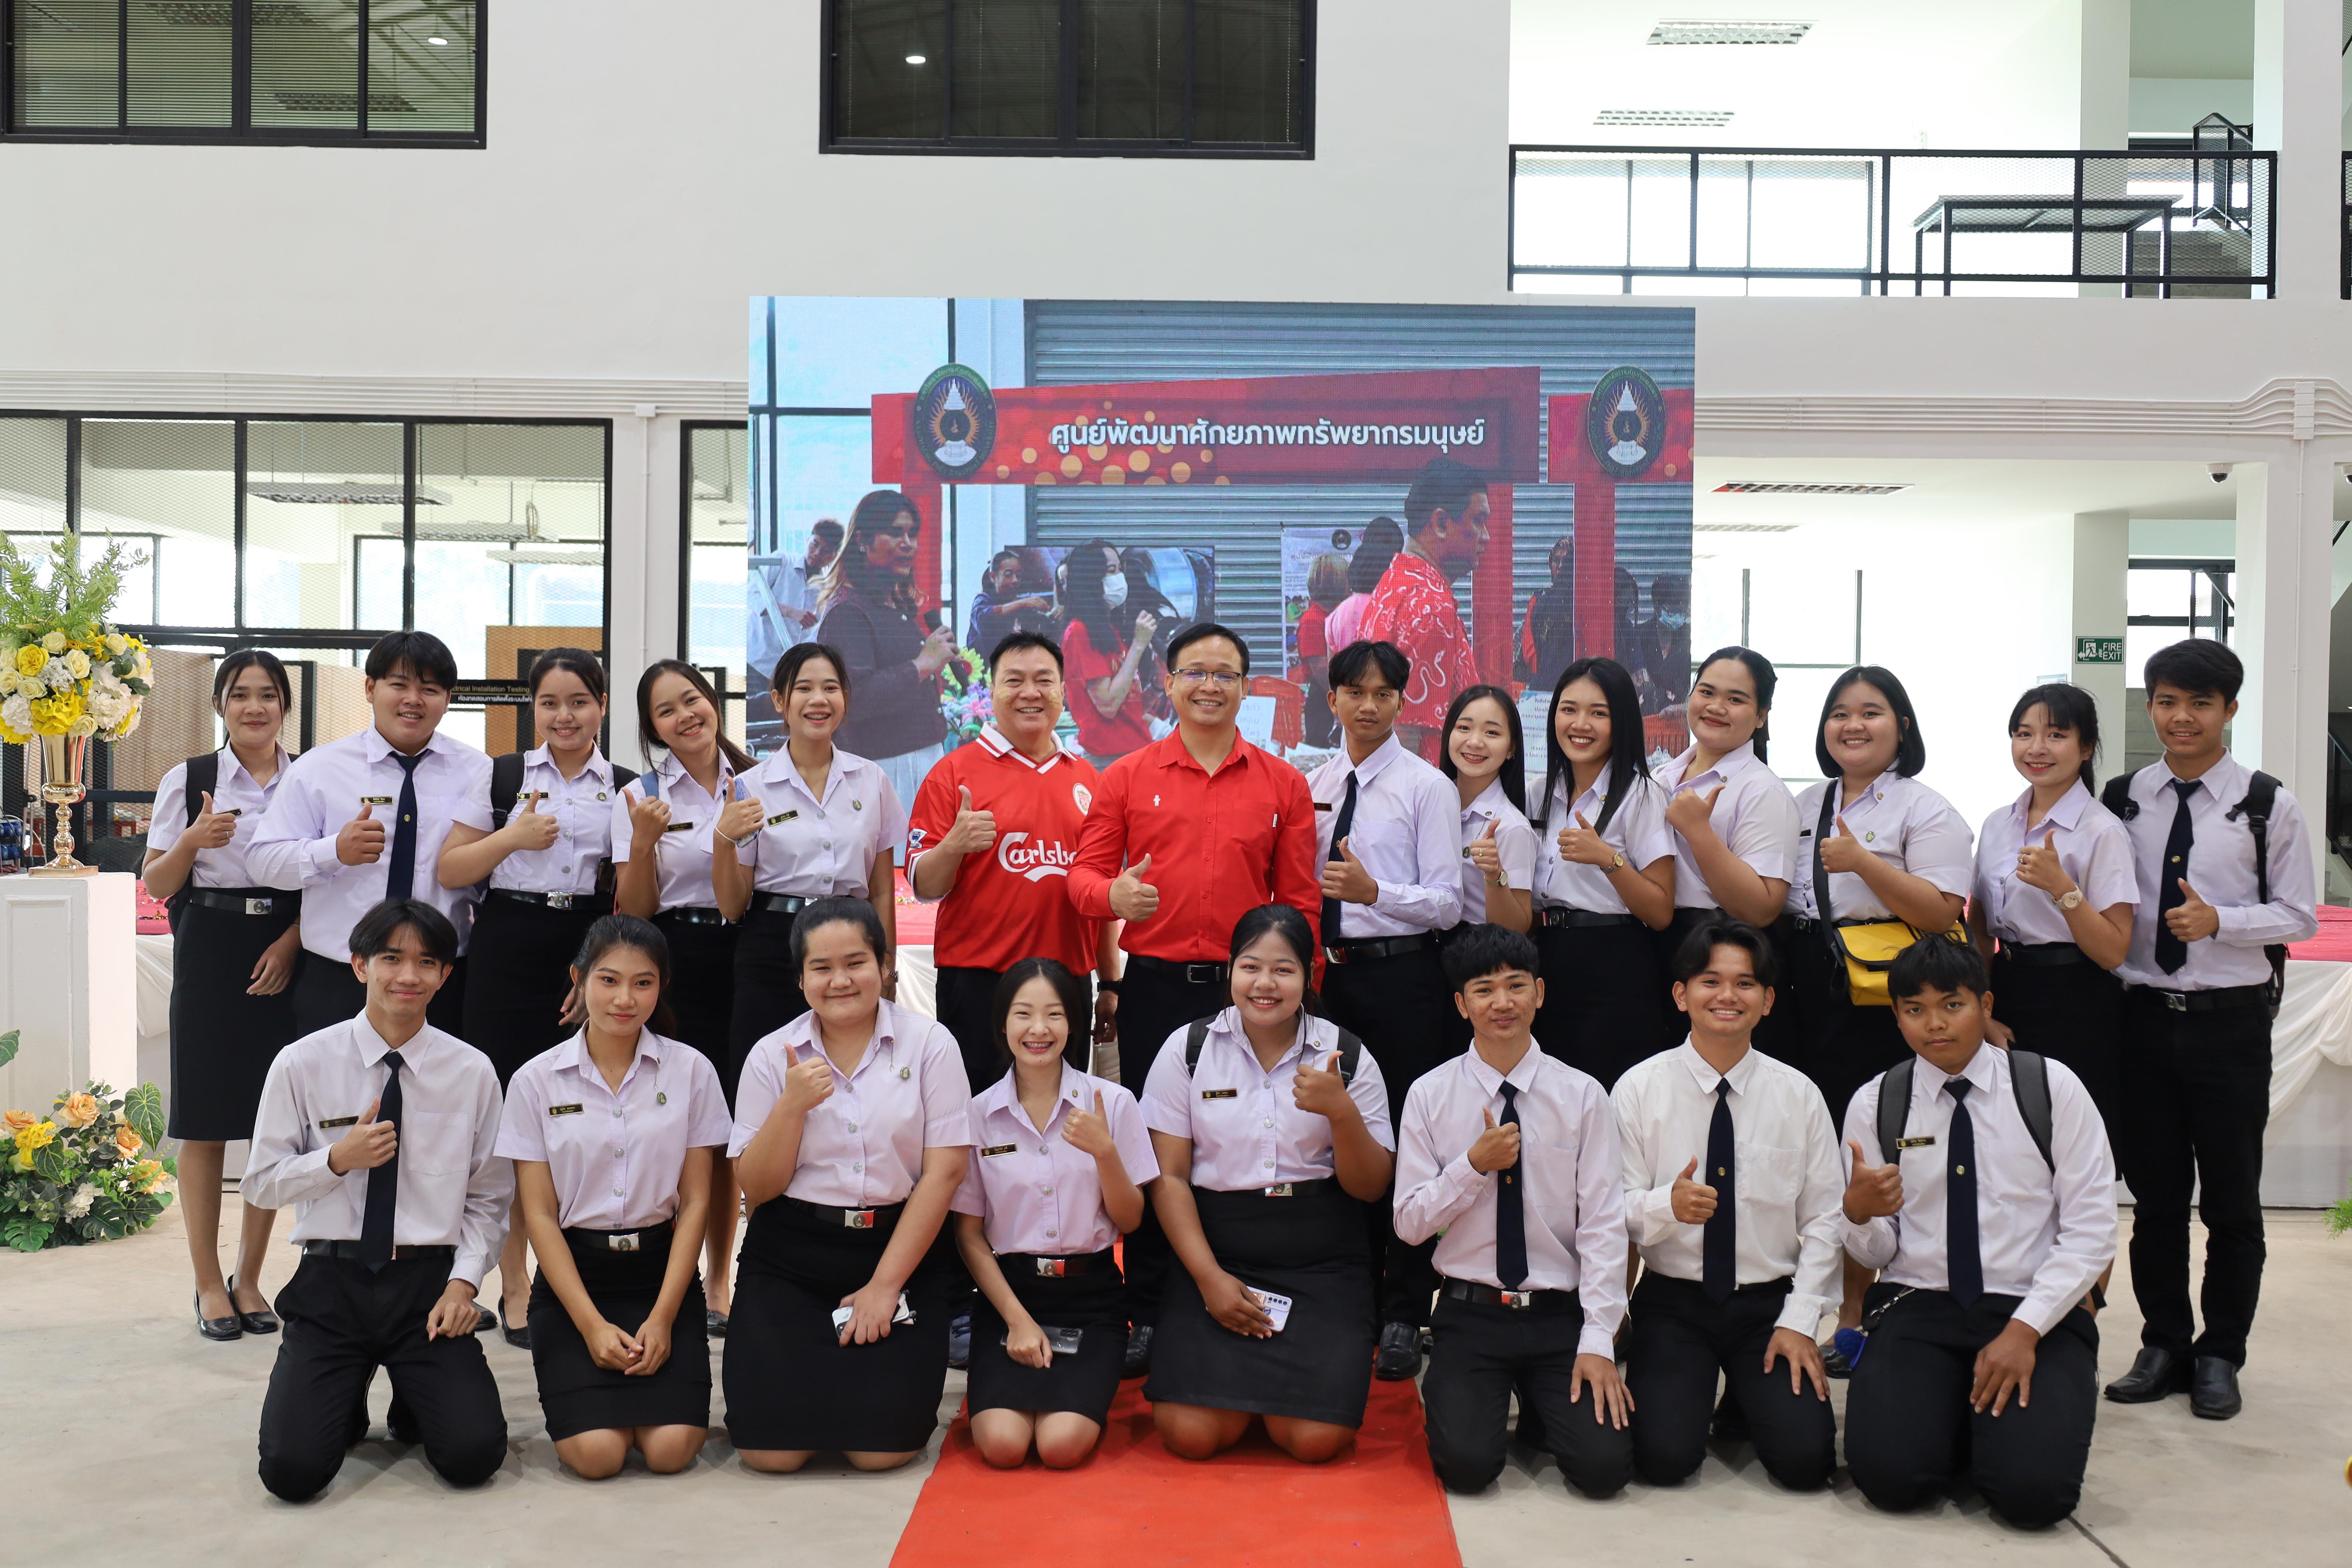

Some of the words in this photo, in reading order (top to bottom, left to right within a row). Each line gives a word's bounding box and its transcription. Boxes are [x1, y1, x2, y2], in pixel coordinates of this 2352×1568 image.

[1051, 418, 1485, 454] ศูนย์พัฒนาศักยภาพทรัพยากรมนุษย์
[2103, 642, 2122, 651] FIRE
[2103, 652, 2121, 660] EXIT
